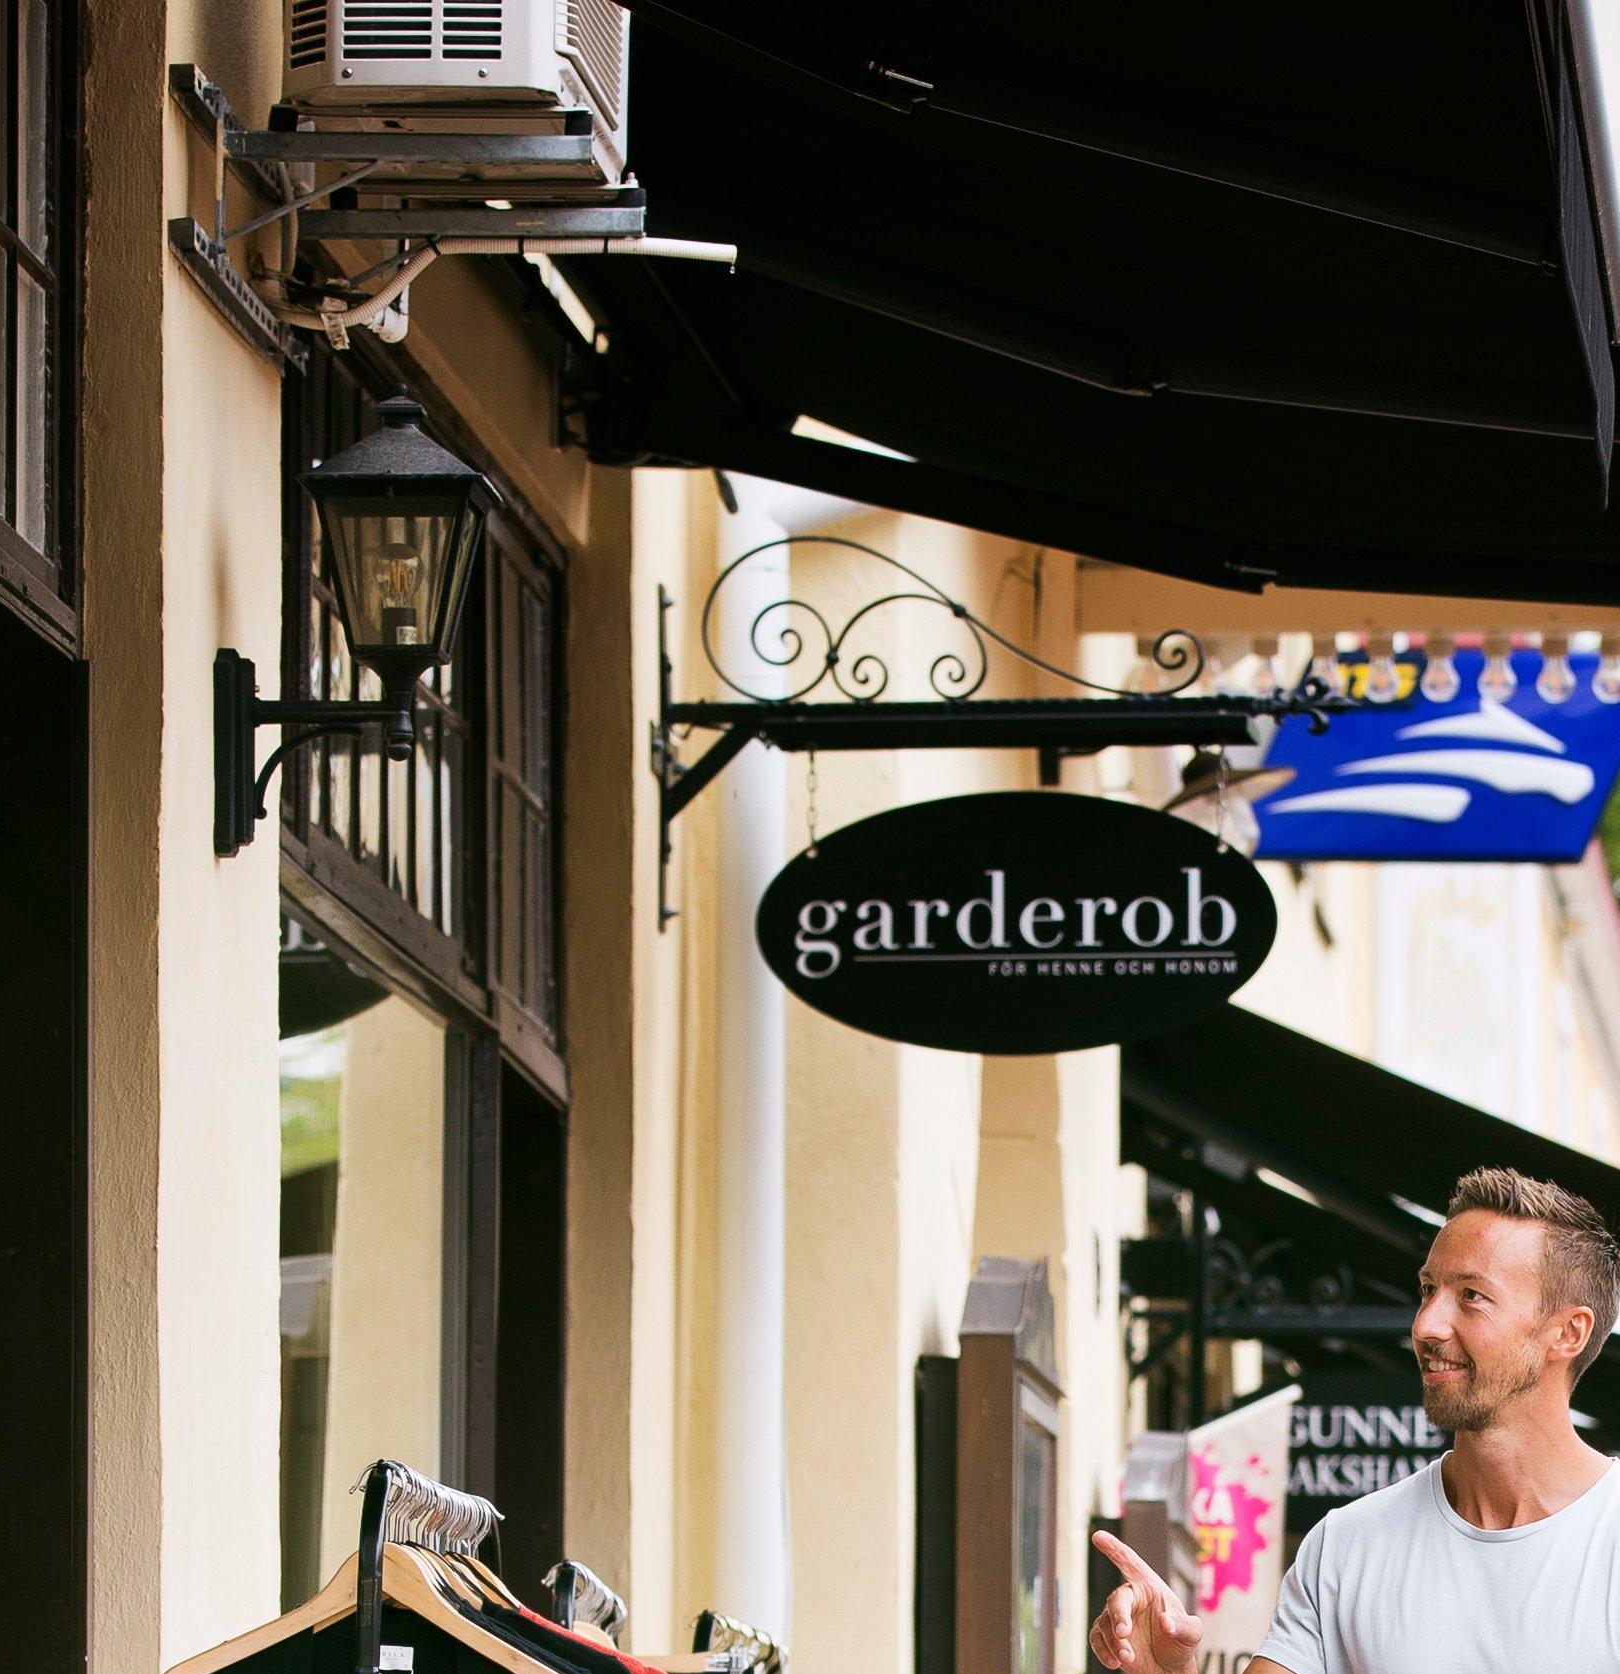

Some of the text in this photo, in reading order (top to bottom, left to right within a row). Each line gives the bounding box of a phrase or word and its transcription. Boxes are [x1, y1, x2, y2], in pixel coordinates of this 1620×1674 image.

[795, 867, 1237, 979] garderob
[1036, 960, 1105, 977] HENNE
[1113, 959, 1156, 976] OCH
[1165, 959, 1238, 976] HONOM
